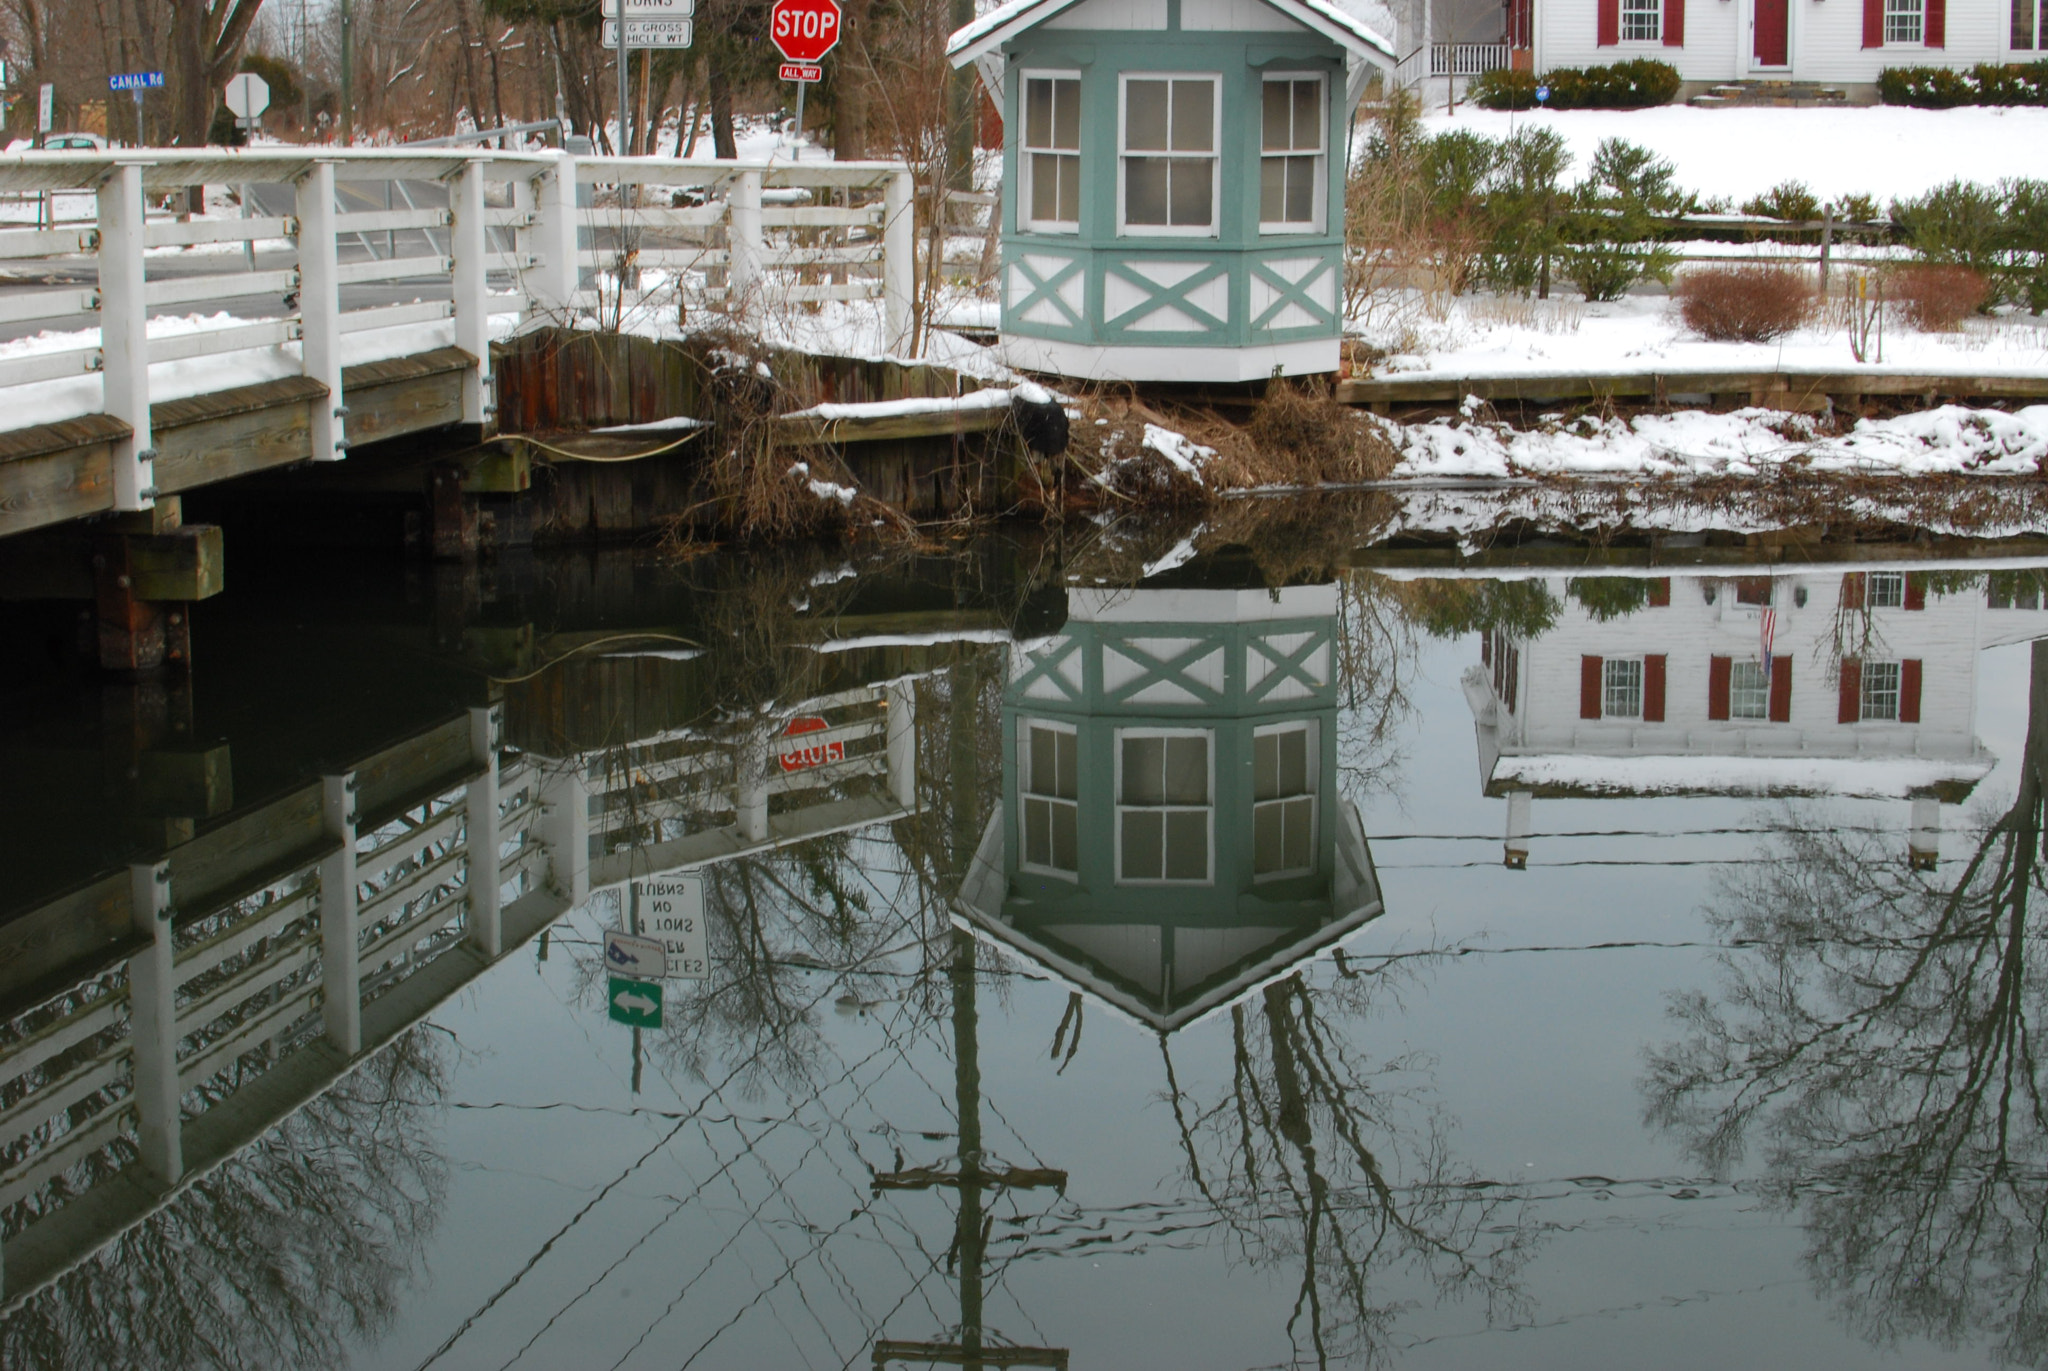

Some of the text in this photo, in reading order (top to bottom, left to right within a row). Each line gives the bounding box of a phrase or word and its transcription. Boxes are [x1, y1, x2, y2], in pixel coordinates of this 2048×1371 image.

[642, 24, 682, 33] GROSS
[776, 10, 835, 38] STOP
[612, 34, 683, 43] VHICLE WT
[784, 68, 817, 78] ALL WAY
[110, 73, 163, 90] CANAL Rd
